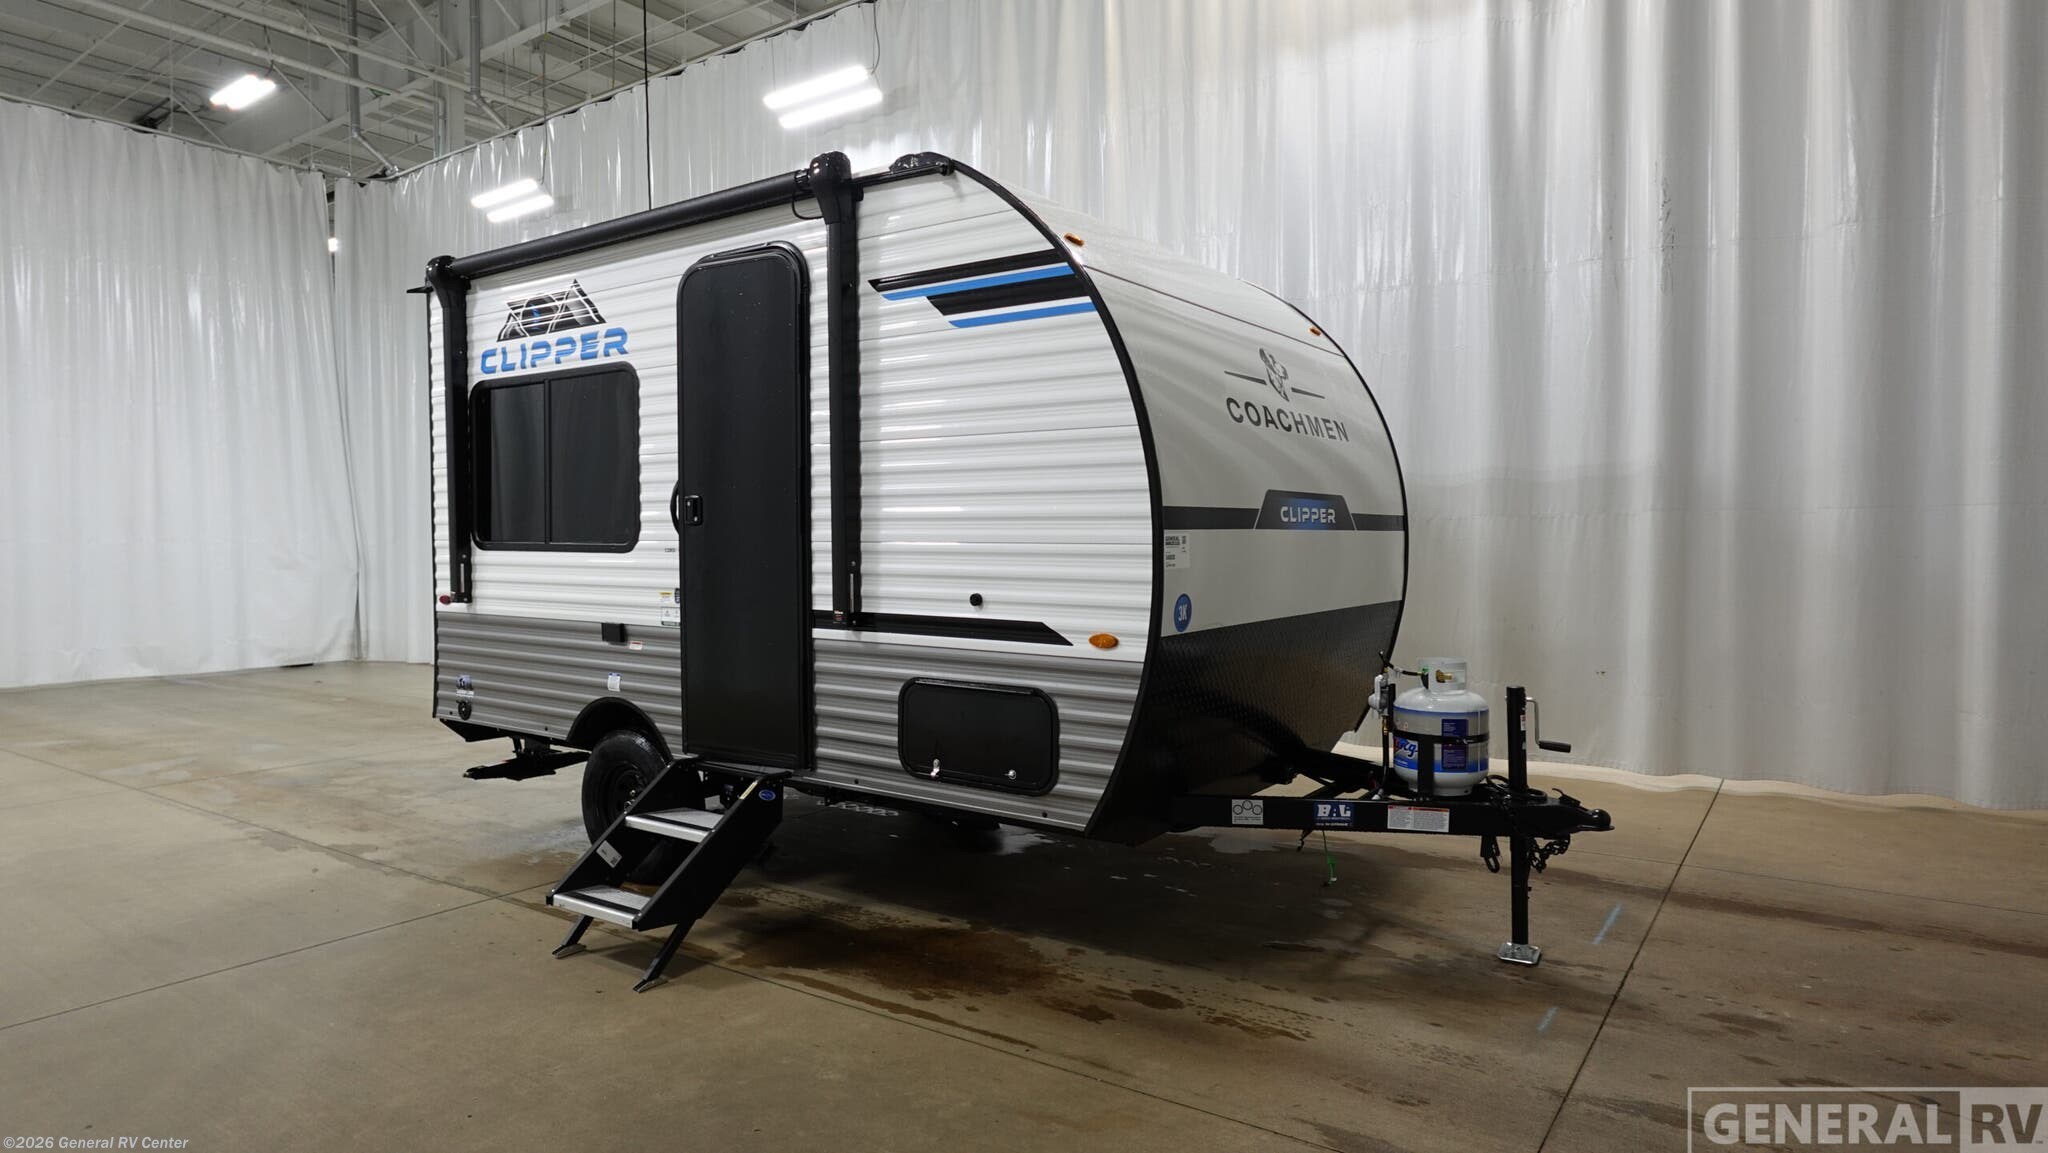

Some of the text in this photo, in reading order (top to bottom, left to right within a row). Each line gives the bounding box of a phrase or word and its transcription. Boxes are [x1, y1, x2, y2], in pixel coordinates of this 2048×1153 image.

[480, 327, 629, 375] CLIPPER
[1226, 397, 1349, 442] COACHMEN
[1280, 506, 1336, 524] CLIPPER
